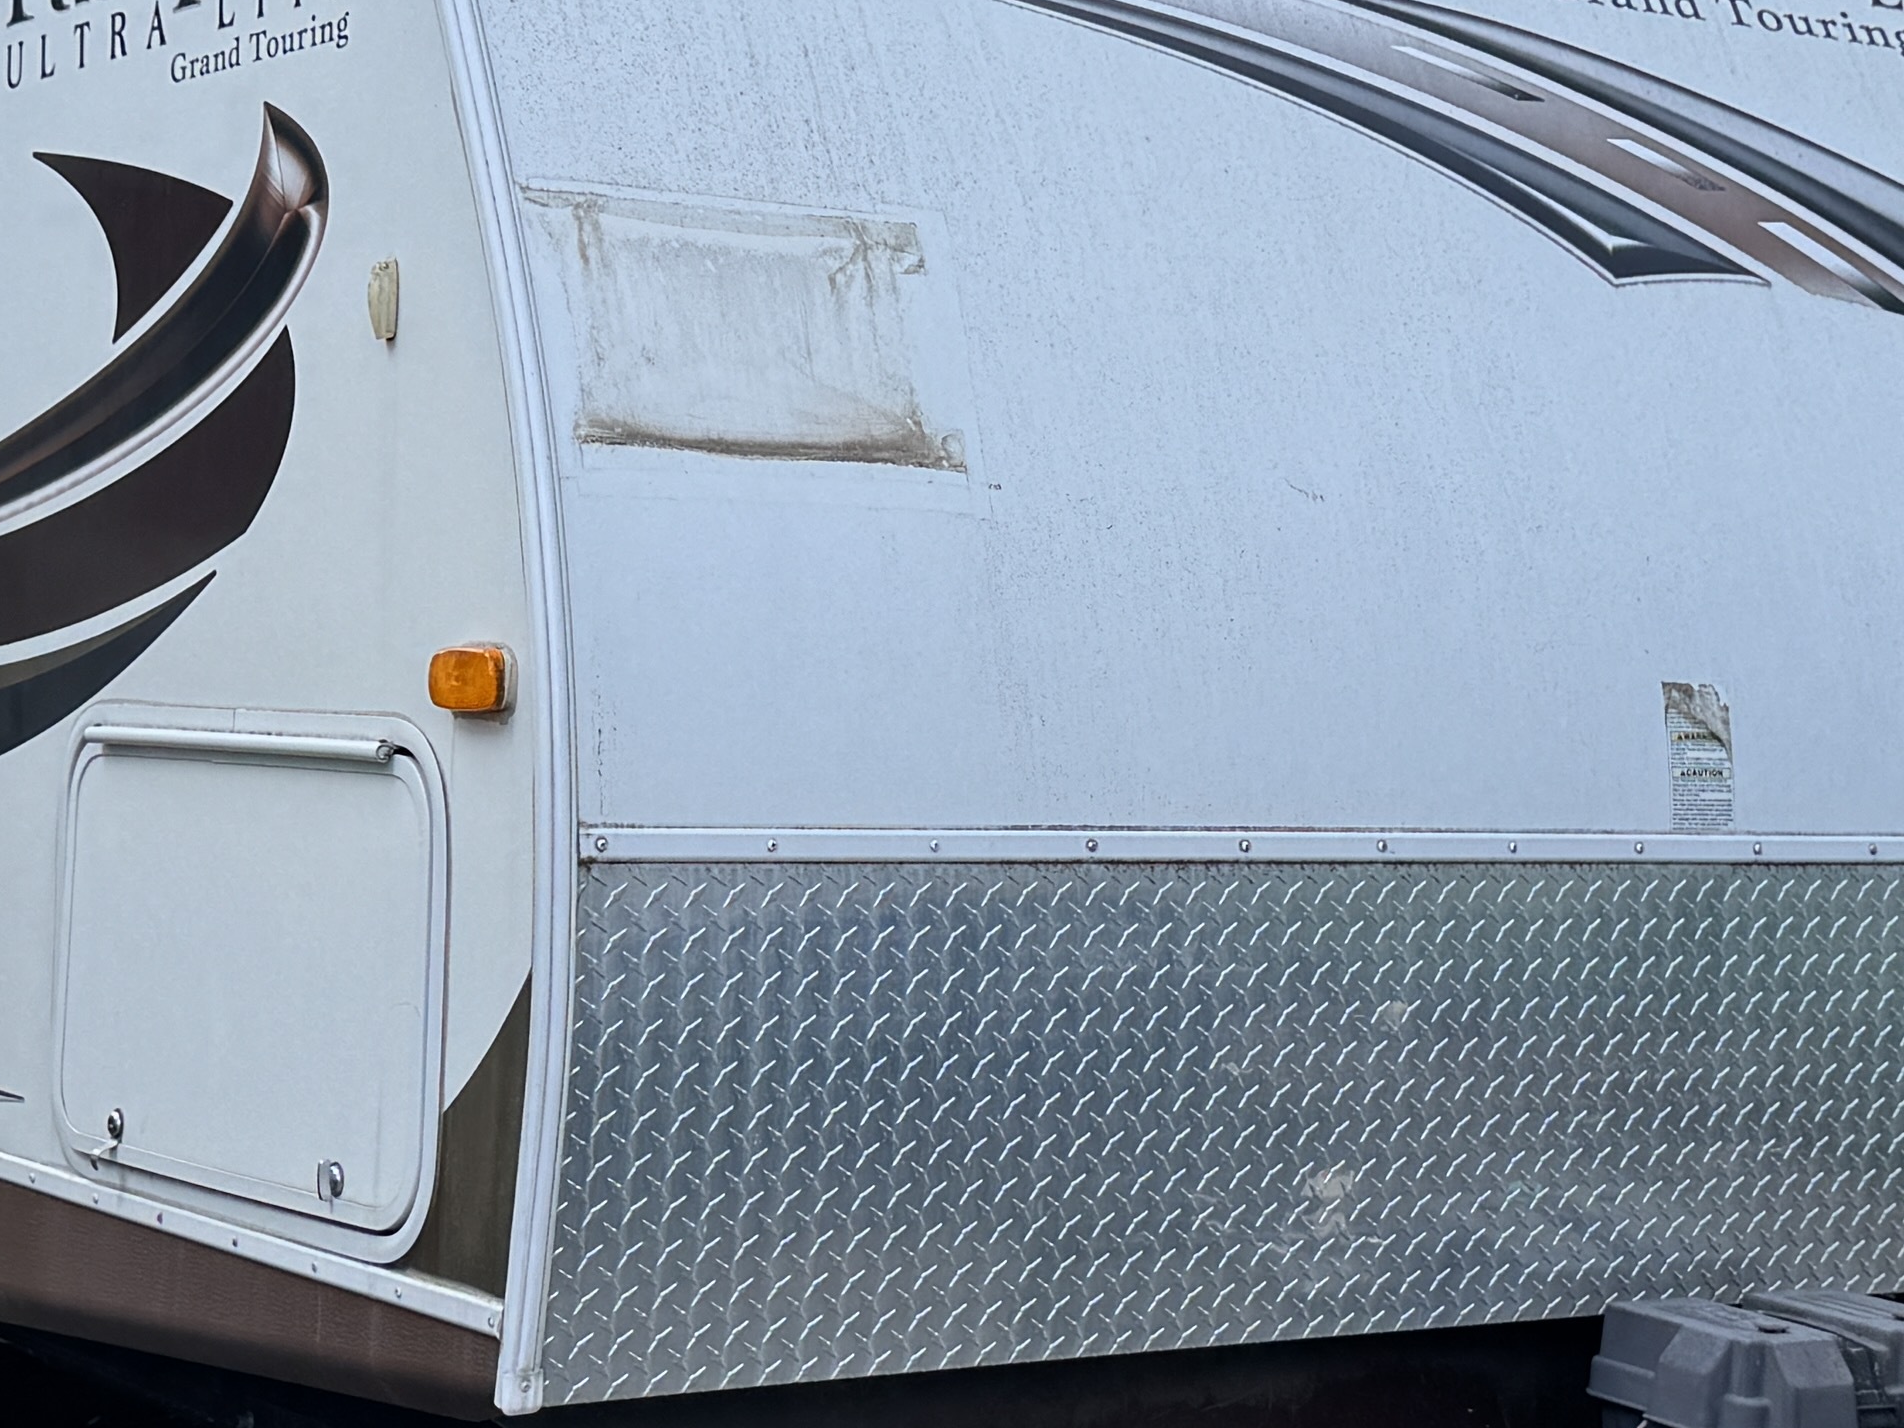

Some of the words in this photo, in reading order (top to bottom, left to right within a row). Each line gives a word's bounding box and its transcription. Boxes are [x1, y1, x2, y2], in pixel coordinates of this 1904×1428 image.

[5, 0, 167, 89] ULTRA
[169, 36, 241, 84] Grand
[249, 12, 350, 63] Touring
[1686, 768, 1723, 777] CAUTION
